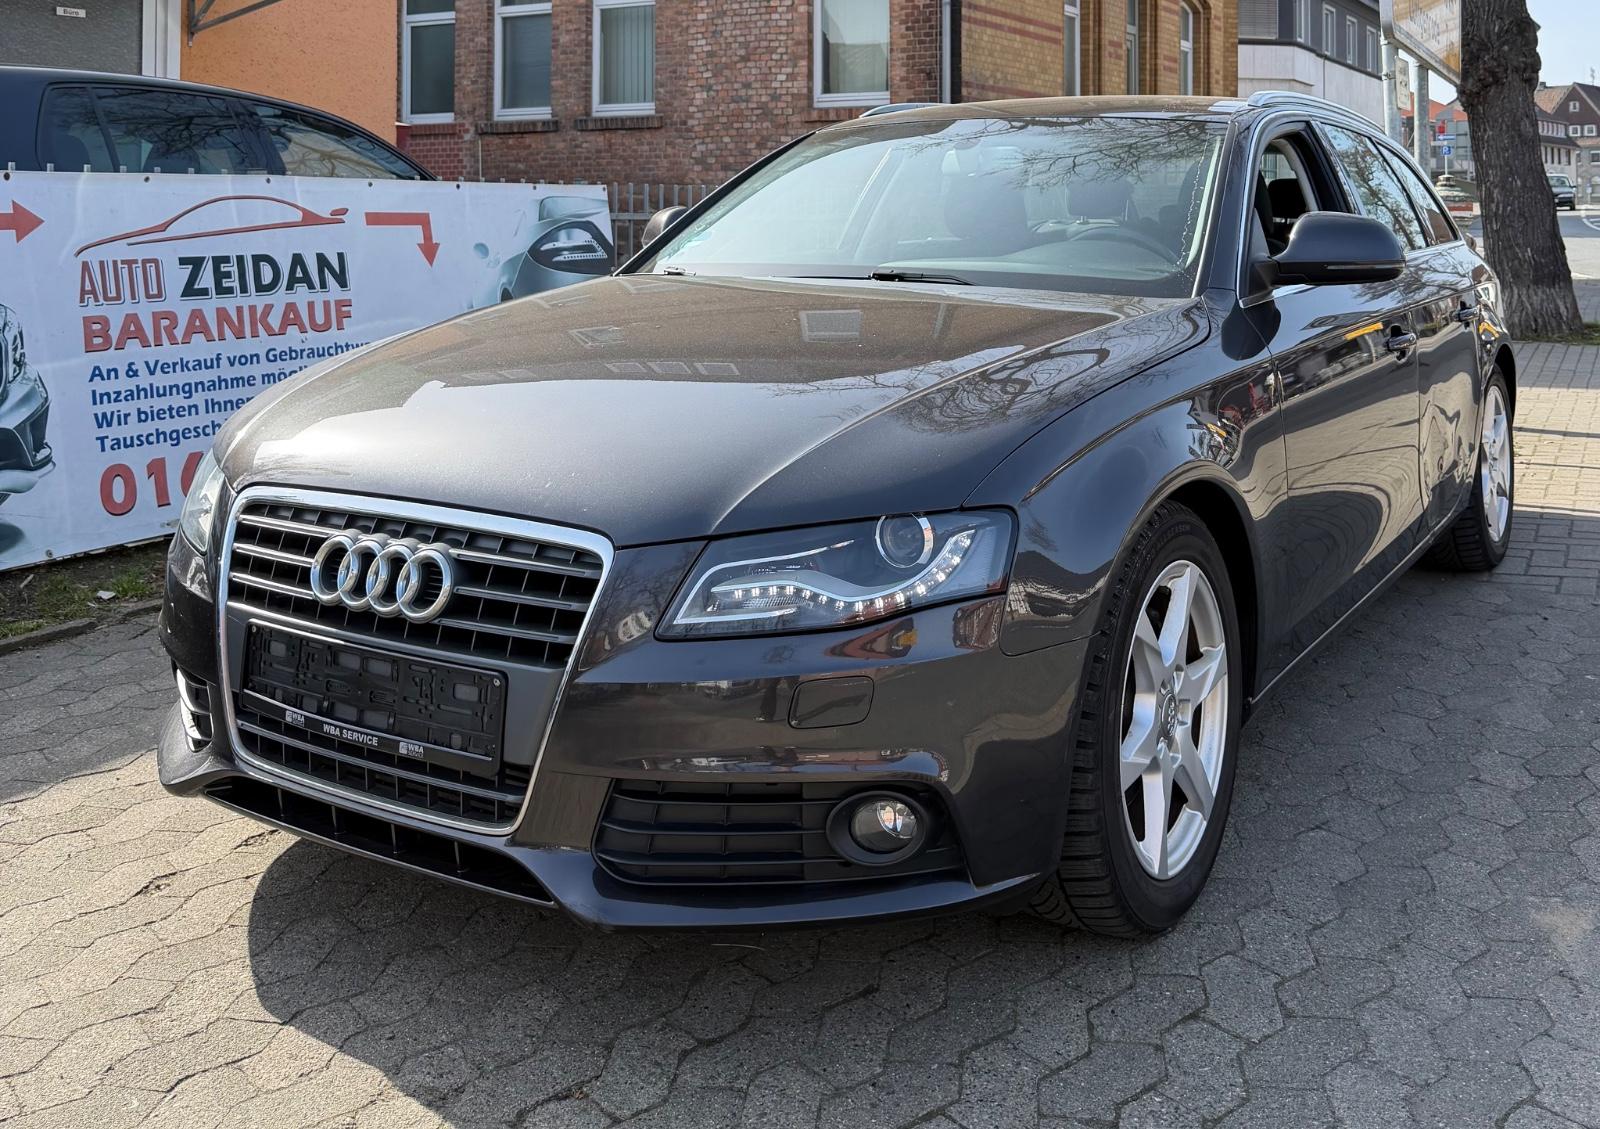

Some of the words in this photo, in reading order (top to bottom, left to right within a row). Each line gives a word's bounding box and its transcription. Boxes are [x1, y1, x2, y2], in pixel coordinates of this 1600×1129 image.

[79, 257, 166, 306] AUTO
[178, 251, 351, 300] ZEIDAN
[82, 298, 353, 353] BARANKAUF
[88, 365, 119, 383] An
[125, 361, 139, 379] &
[144, 352, 222, 376] Verkauf
[227, 352, 261, 367] von
[91, 373, 257, 406] Inzahlungnahme
[93, 409, 131, 429] Wir
[137, 402, 199, 424] bieten
[292, 711, 305, 724] WBA
[323, 723, 340, 737] WBA
[342, 729, 378, 746] SERVICE
[407, 742, 424, 754] WBA
